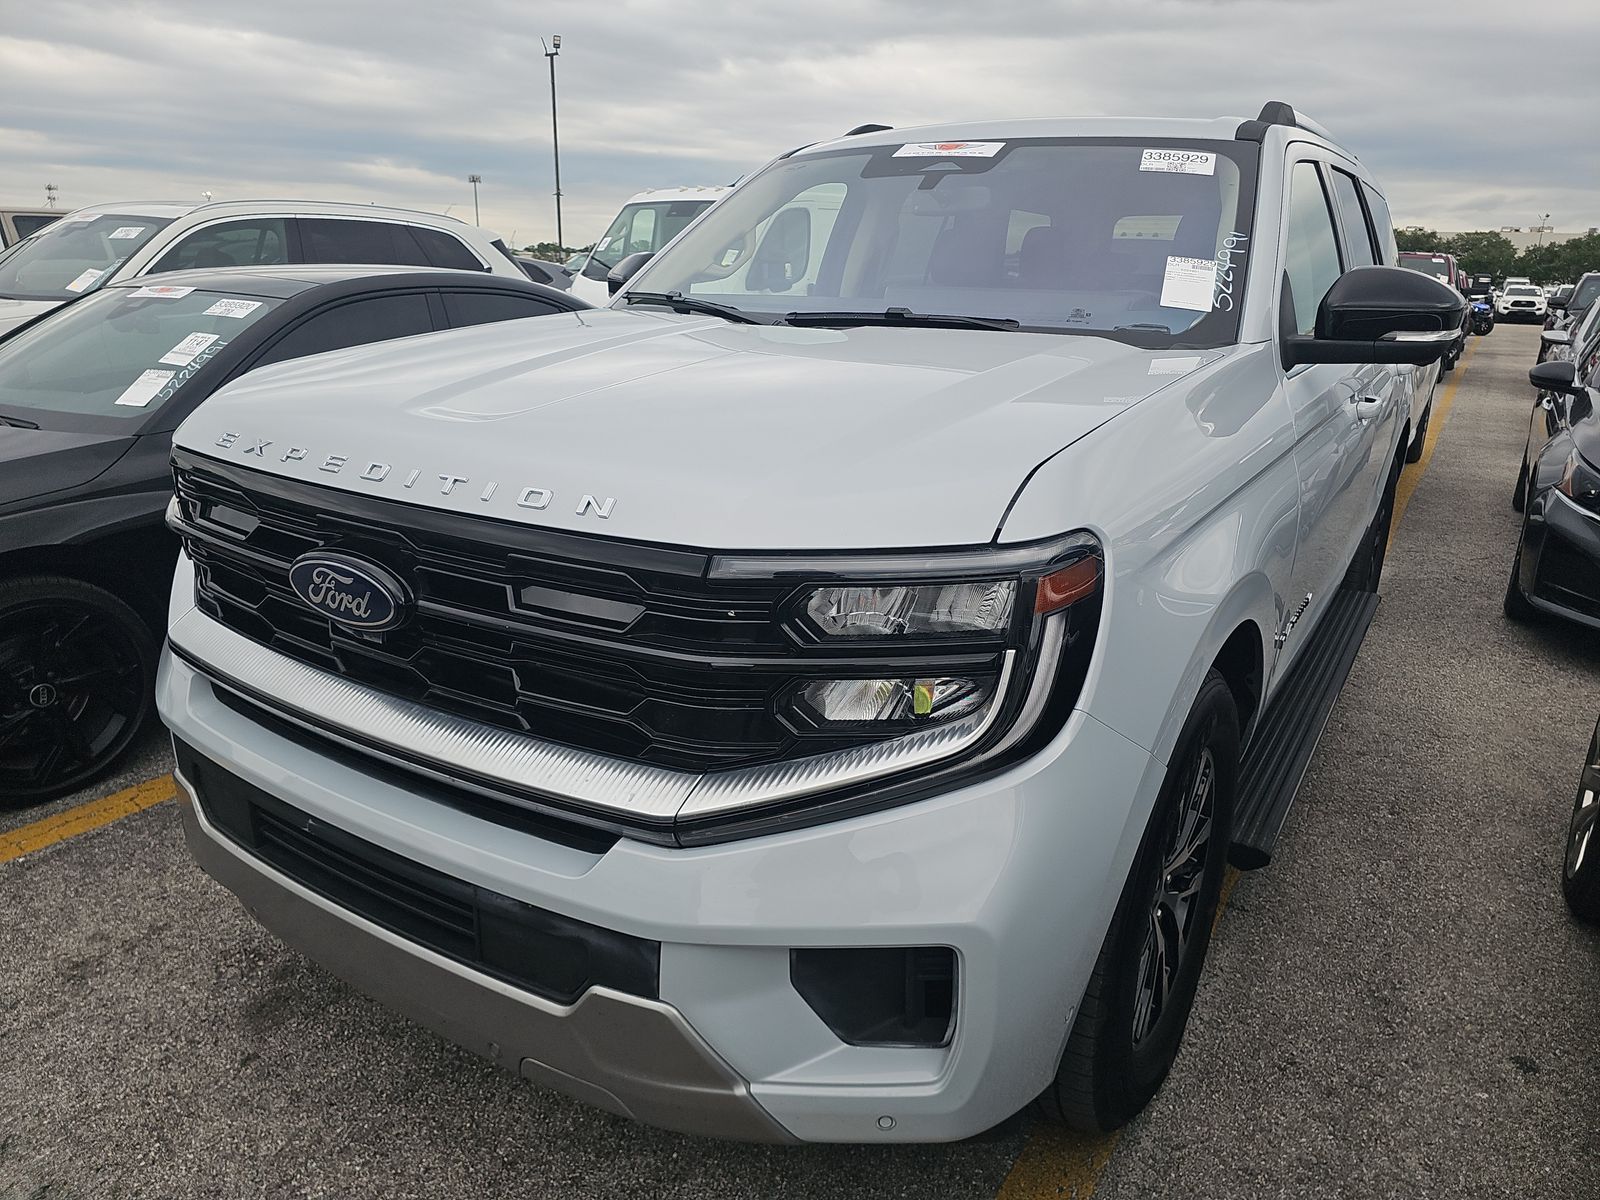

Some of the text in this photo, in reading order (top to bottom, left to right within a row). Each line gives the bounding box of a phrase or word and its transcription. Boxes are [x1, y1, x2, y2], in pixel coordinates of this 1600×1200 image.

[1143, 151, 1209, 164] 3385929
[1169, 255, 1217, 268] 3385929
[1213, 231, 1248, 312] 5224991
[157, 340, 228, 401] 5224991
[215, 431, 618, 520] EXPEDITION
[308, 566, 371, 619] Ford
